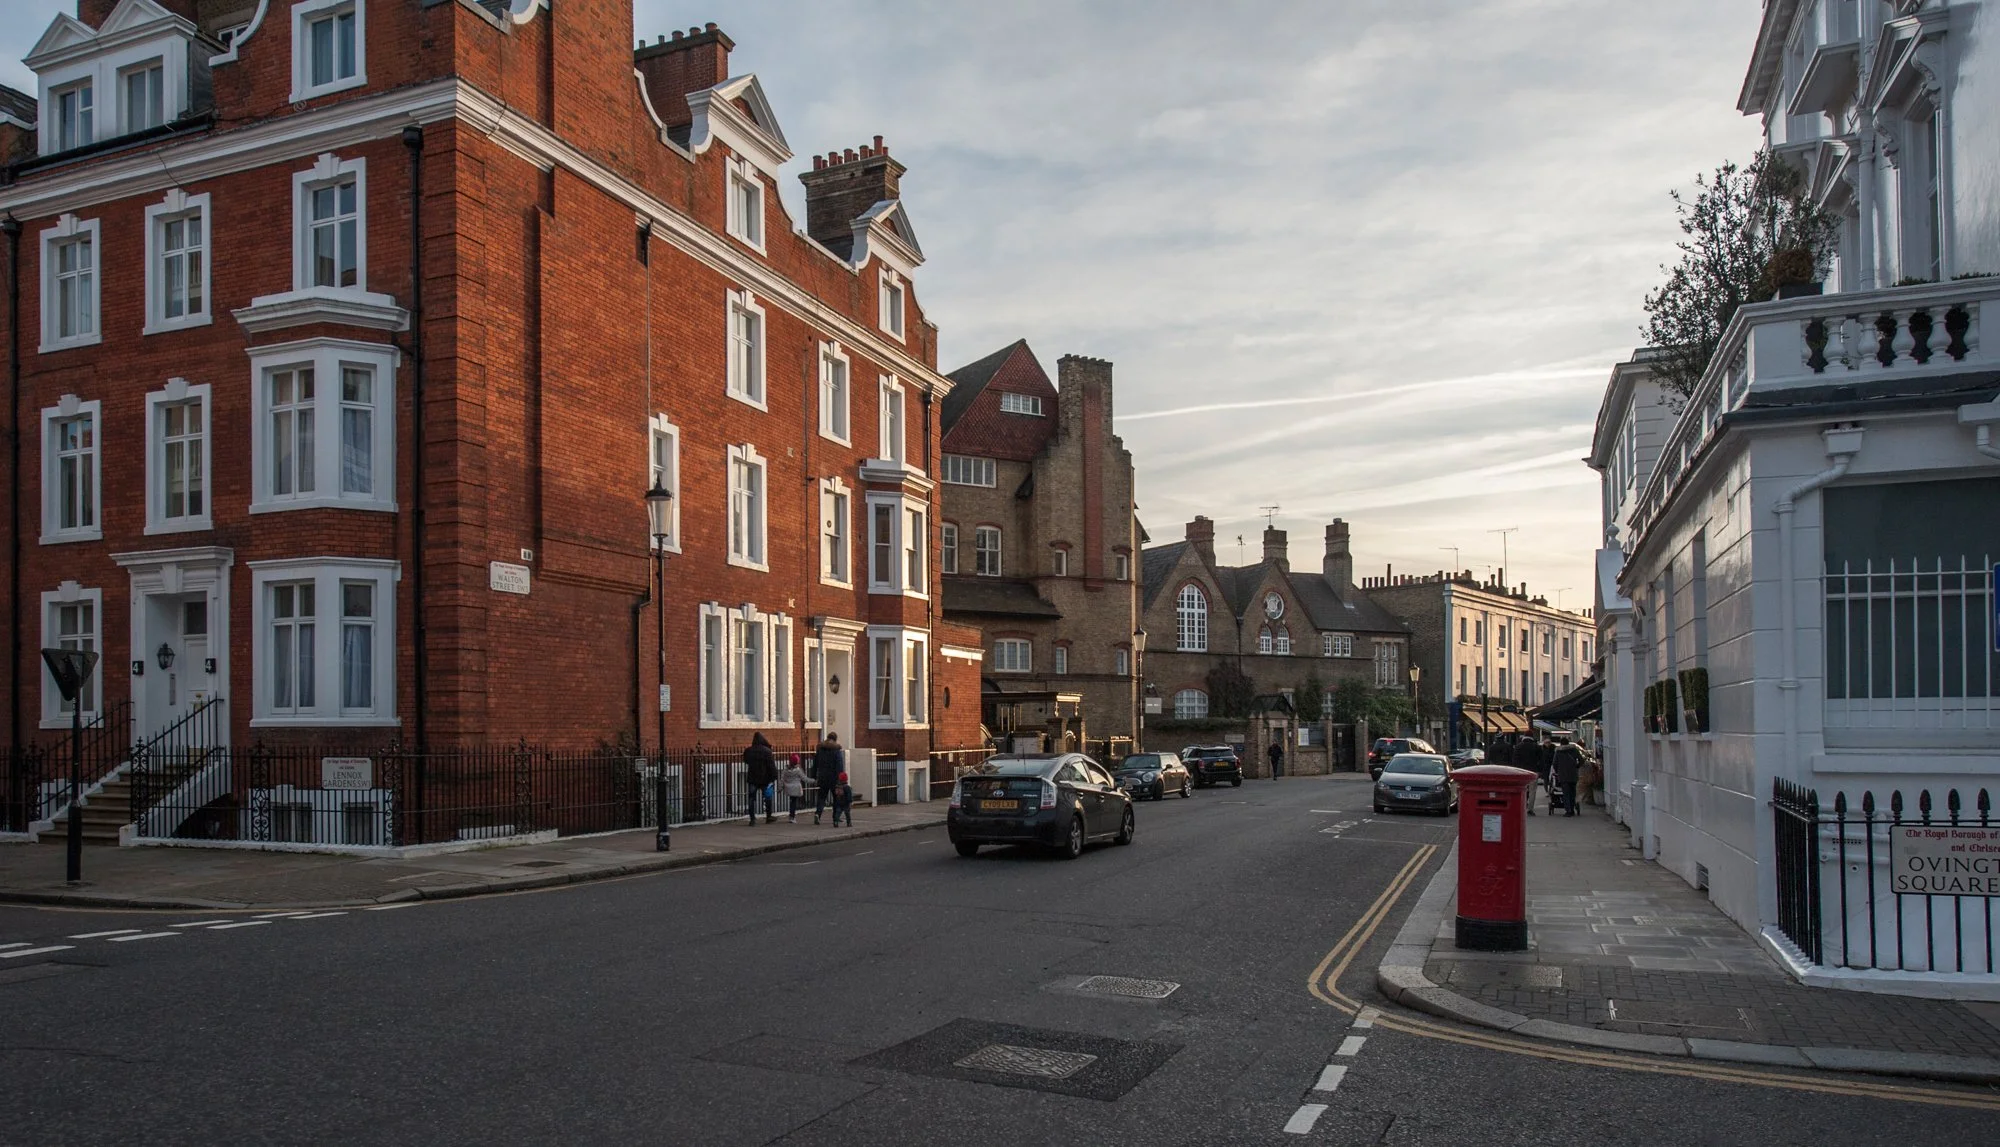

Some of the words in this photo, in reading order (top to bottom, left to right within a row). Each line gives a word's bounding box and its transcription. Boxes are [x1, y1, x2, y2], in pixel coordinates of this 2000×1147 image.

[498, 574, 524, 584] WALTON
[492, 581, 514, 591] STREET
[132, 662, 139, 673] 4
[205, 659, 212, 671] 4
[1905, 829, 1922, 838] The
[1924, 829, 1948, 841] Royal
[1951, 829, 1987, 841] Borough
[1989, 830, 1999, 839] of
[1951, 843, 1966, 852] and
[1897, 874, 1999, 893] SQUARE
